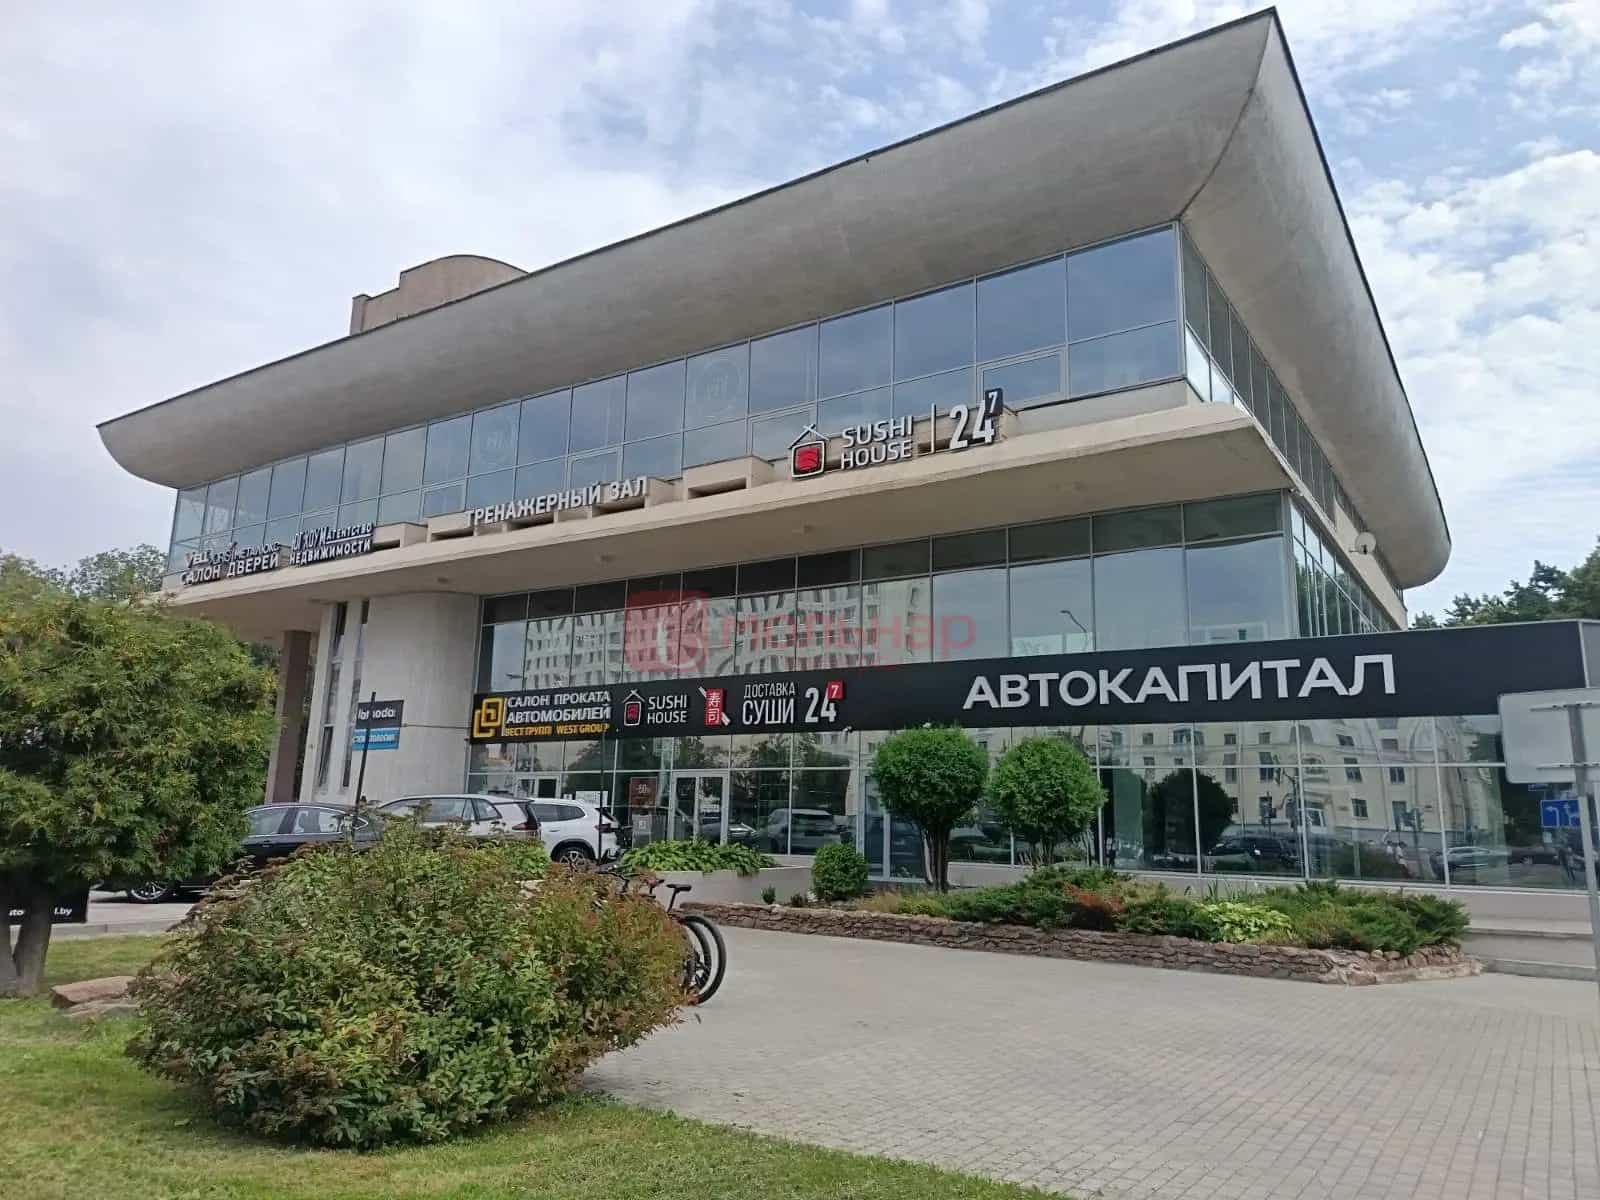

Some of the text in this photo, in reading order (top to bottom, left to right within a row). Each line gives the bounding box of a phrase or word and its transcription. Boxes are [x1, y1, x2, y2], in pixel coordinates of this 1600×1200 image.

[842, 415, 914, 448] SUSHI
[840, 440, 913, 470] HOUSE
[464, 475, 648, 527] ТРЕНАЖЕРНЫЙ ЗАЛ
[289, 539, 371, 566] НЕДВИЖИМОСТИ
[181, 551, 279, 585] САЛОН ДВЕРЕЙ
[744, 682, 796, 699] ДОСТАВКА
[963, 654, 1396, 710] АВТОКАПИТАЛ
[507, 690, 611, 708] САЛОН ПРОКАТА
[648, 694, 688, 710] SUSHI
[742, 698, 794, 726] СУШИ
[506, 703, 612, 724] АВТОМОБИЛЕЙ
[647, 710, 688, 724] HOUSE
